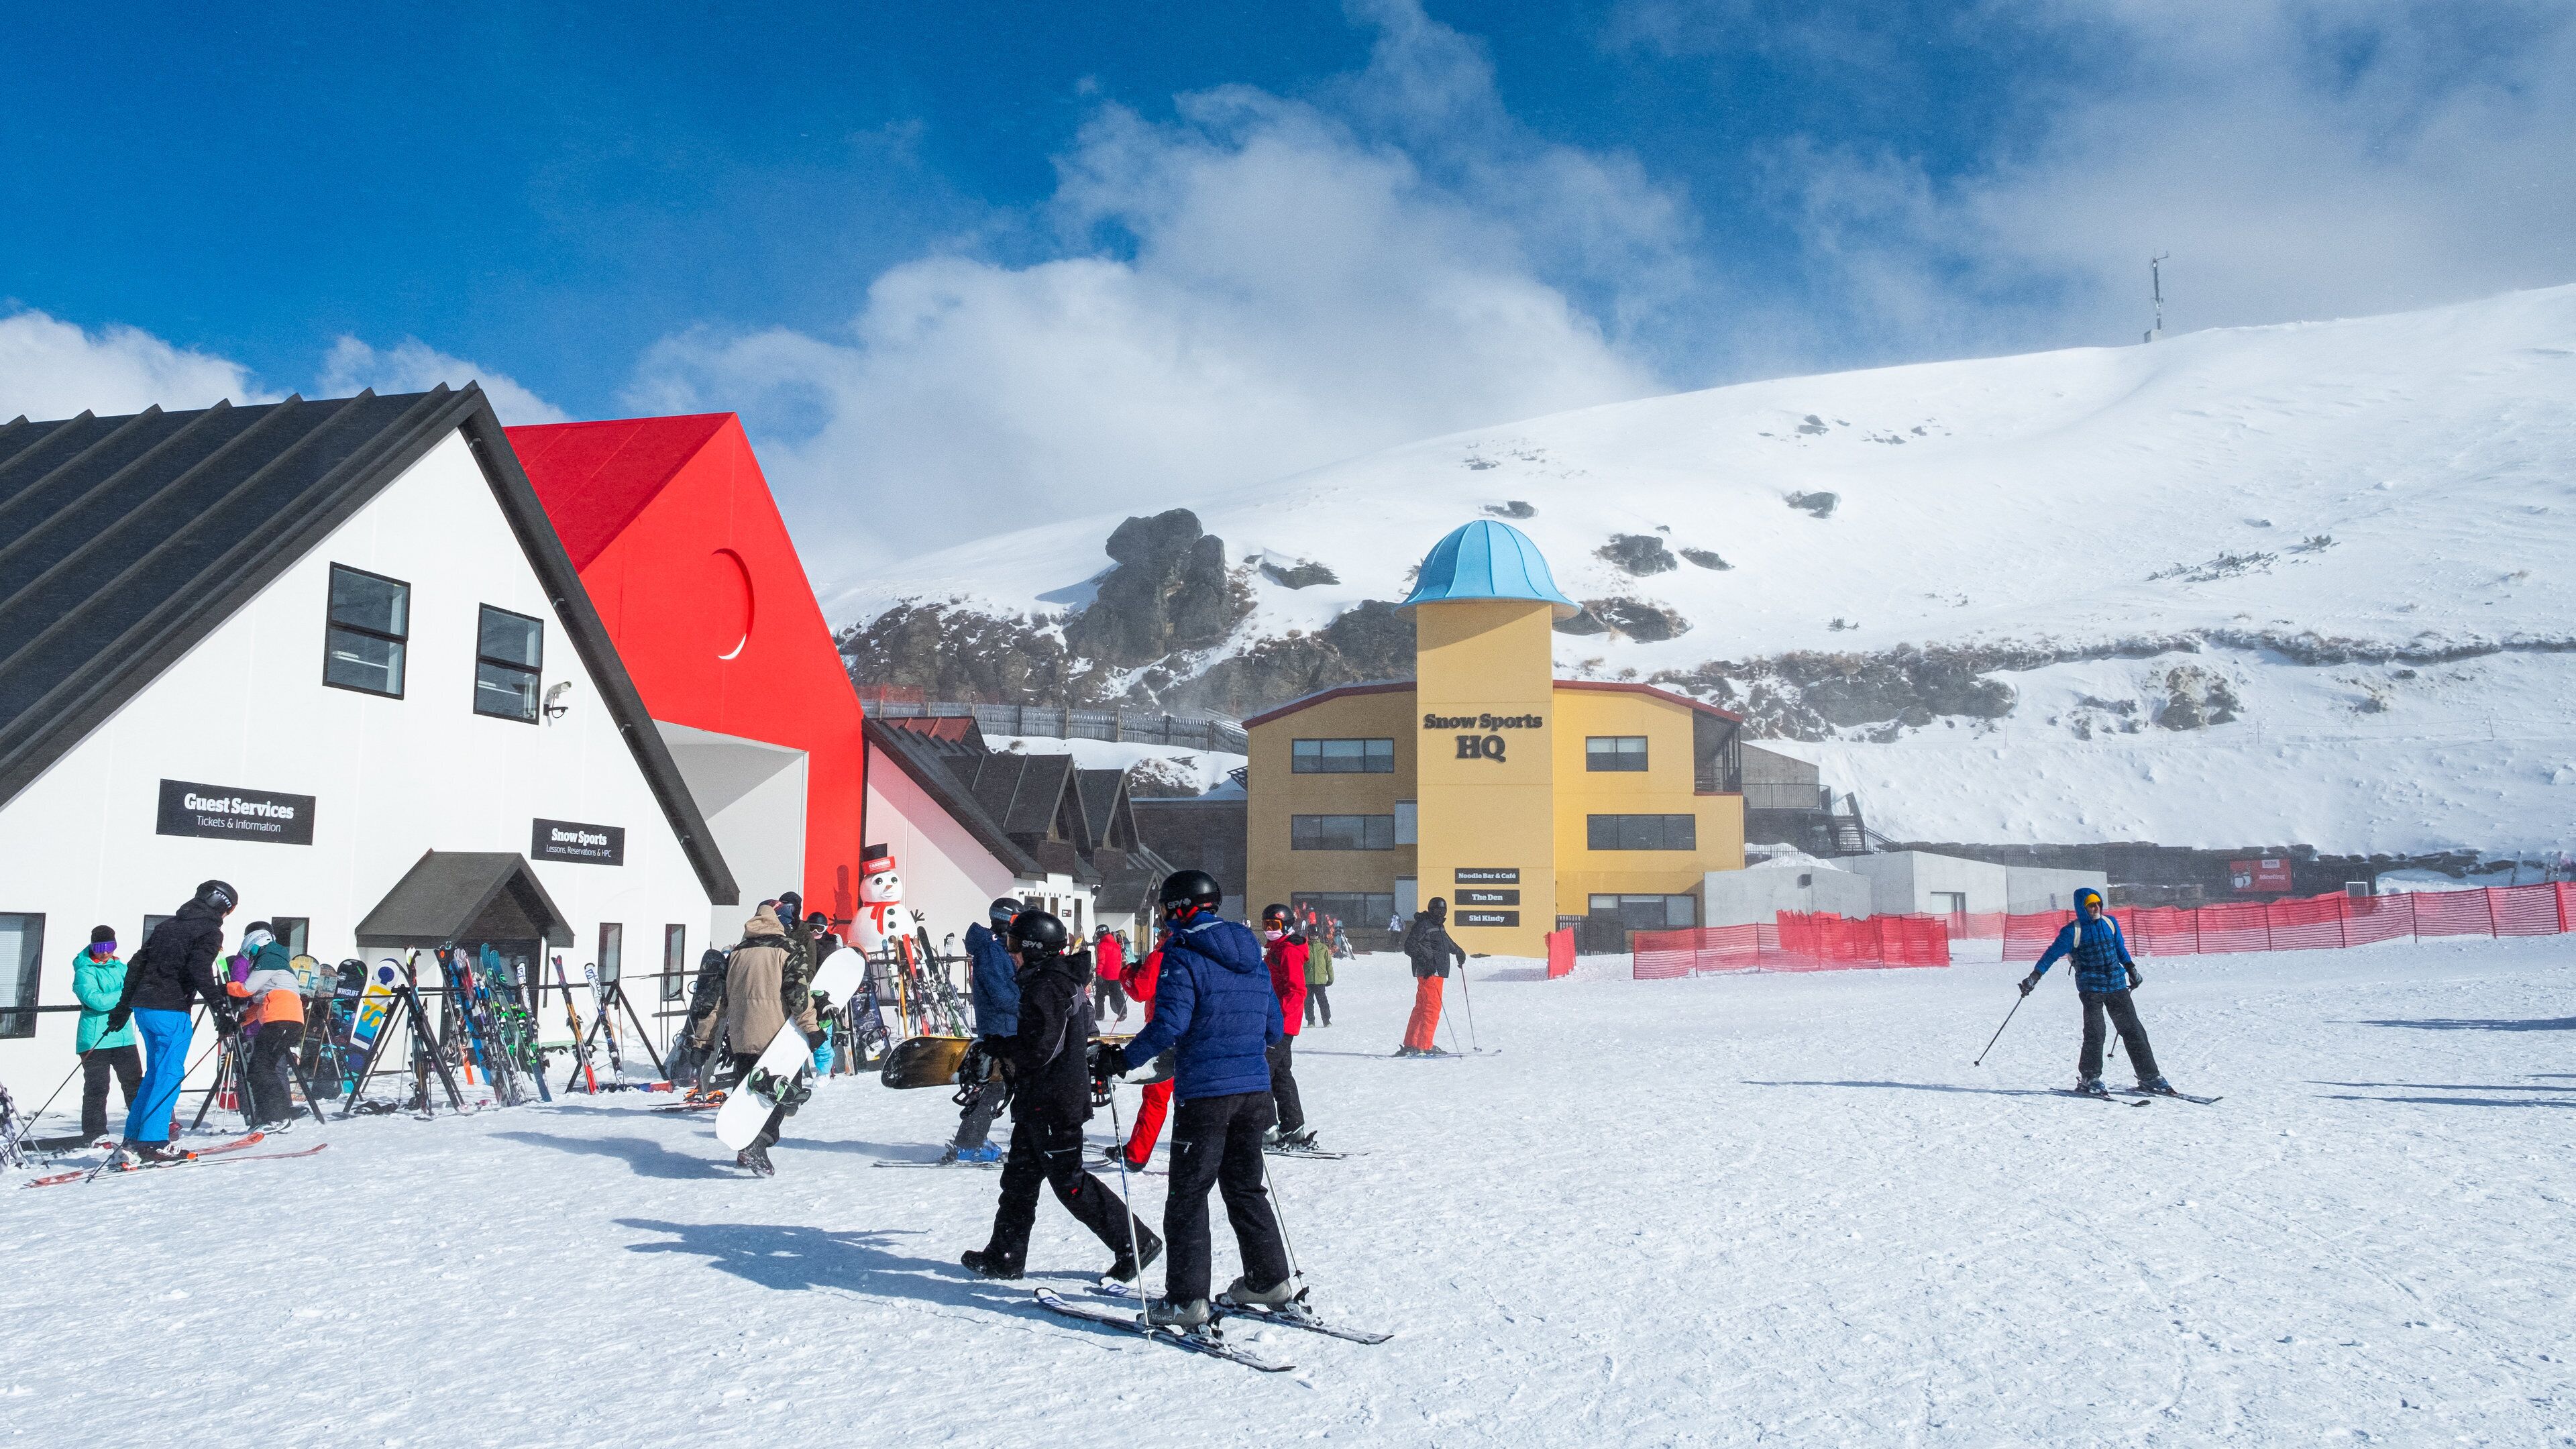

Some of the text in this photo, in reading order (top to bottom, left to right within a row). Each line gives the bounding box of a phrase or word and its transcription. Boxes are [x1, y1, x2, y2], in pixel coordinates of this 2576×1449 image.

[1424, 712, 1543, 732] Snow Sports
[1455, 735, 1506, 763] HQ
[184, 792, 294, 820] Guest Services
[196, 814, 281, 833] Tickets & Information
[551, 827, 607, 847] Snow Sports
[567, 846, 596, 857] Reservations
[596, 849, 601, 857] &
[1481, 914, 1505, 923] Kindy
[1151, 1313, 1173, 1321] ATOMIC
